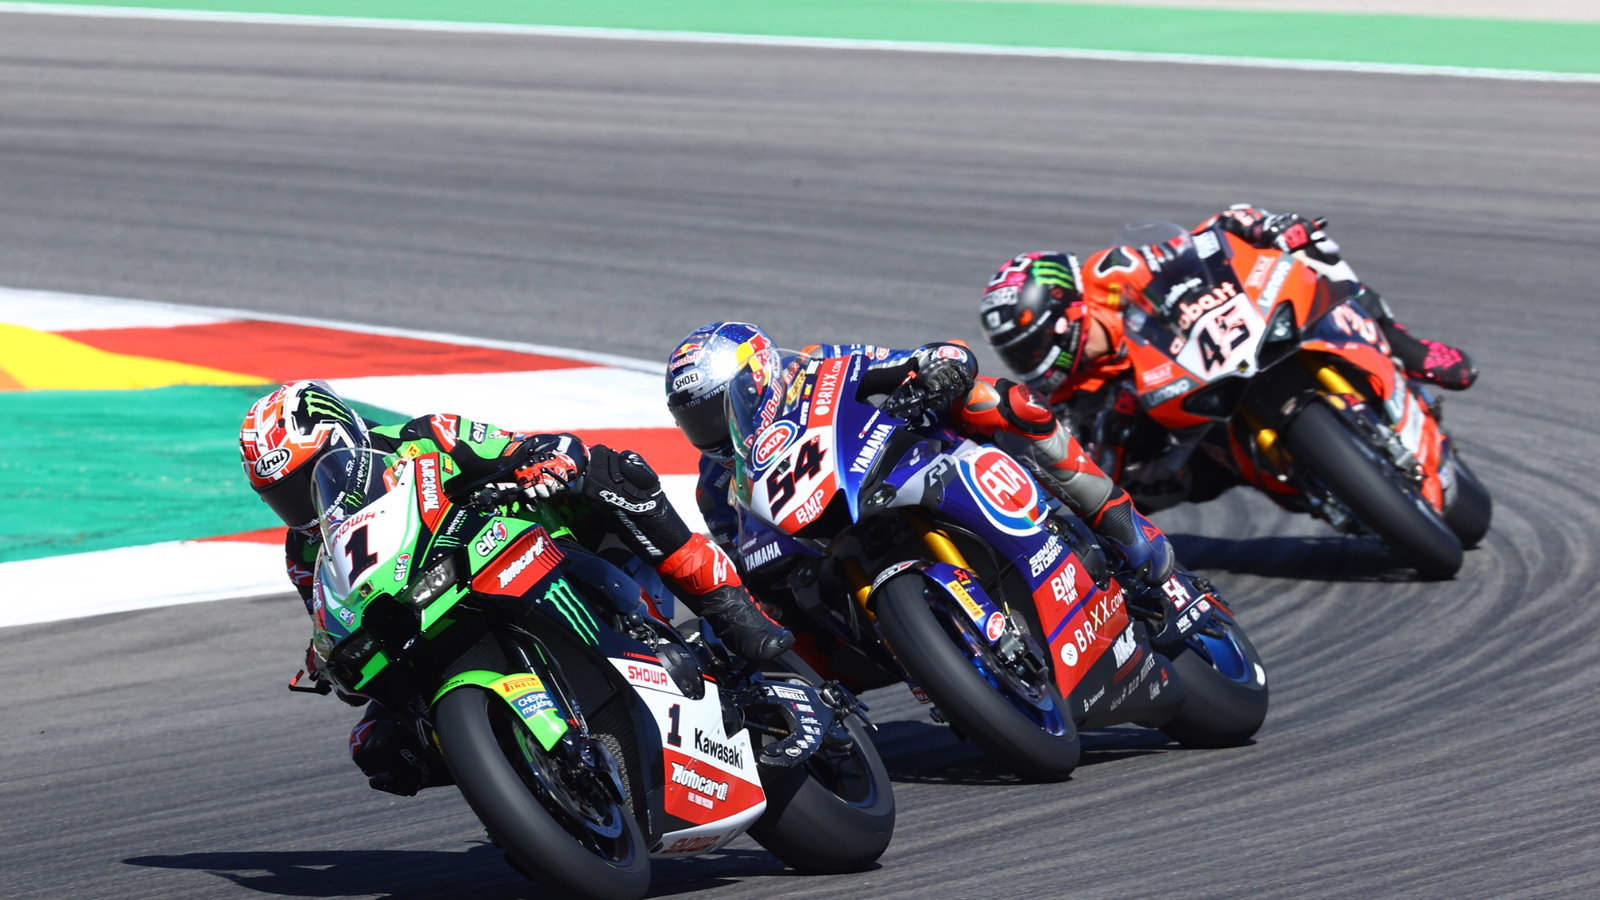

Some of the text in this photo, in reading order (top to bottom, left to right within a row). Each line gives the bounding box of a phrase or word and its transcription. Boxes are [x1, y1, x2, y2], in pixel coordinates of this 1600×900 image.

[1197, 305, 1250, 373] 45
[674, 372, 699, 390] SHOEI
[765, 378, 783, 419] Bull
[472, 421, 487, 443] elf
[758, 430, 786, 459] PATA
[849, 423, 893, 474] YAMAHA
[257, 450, 285, 477] Arai
[766, 434, 829, 521] 54
[795, 488, 825, 524] BMP
[344, 524, 378, 588] 1
[476, 529, 497, 557] elf
[745, 541, 782, 571] YAMAHA
[1050, 563, 1076, 602] BMP
[1161, 575, 1192, 611] 54
[628, 665, 668, 686] SHOWA
[667, 703, 682, 748] 1
[694, 728, 744, 770] Kawasaki
